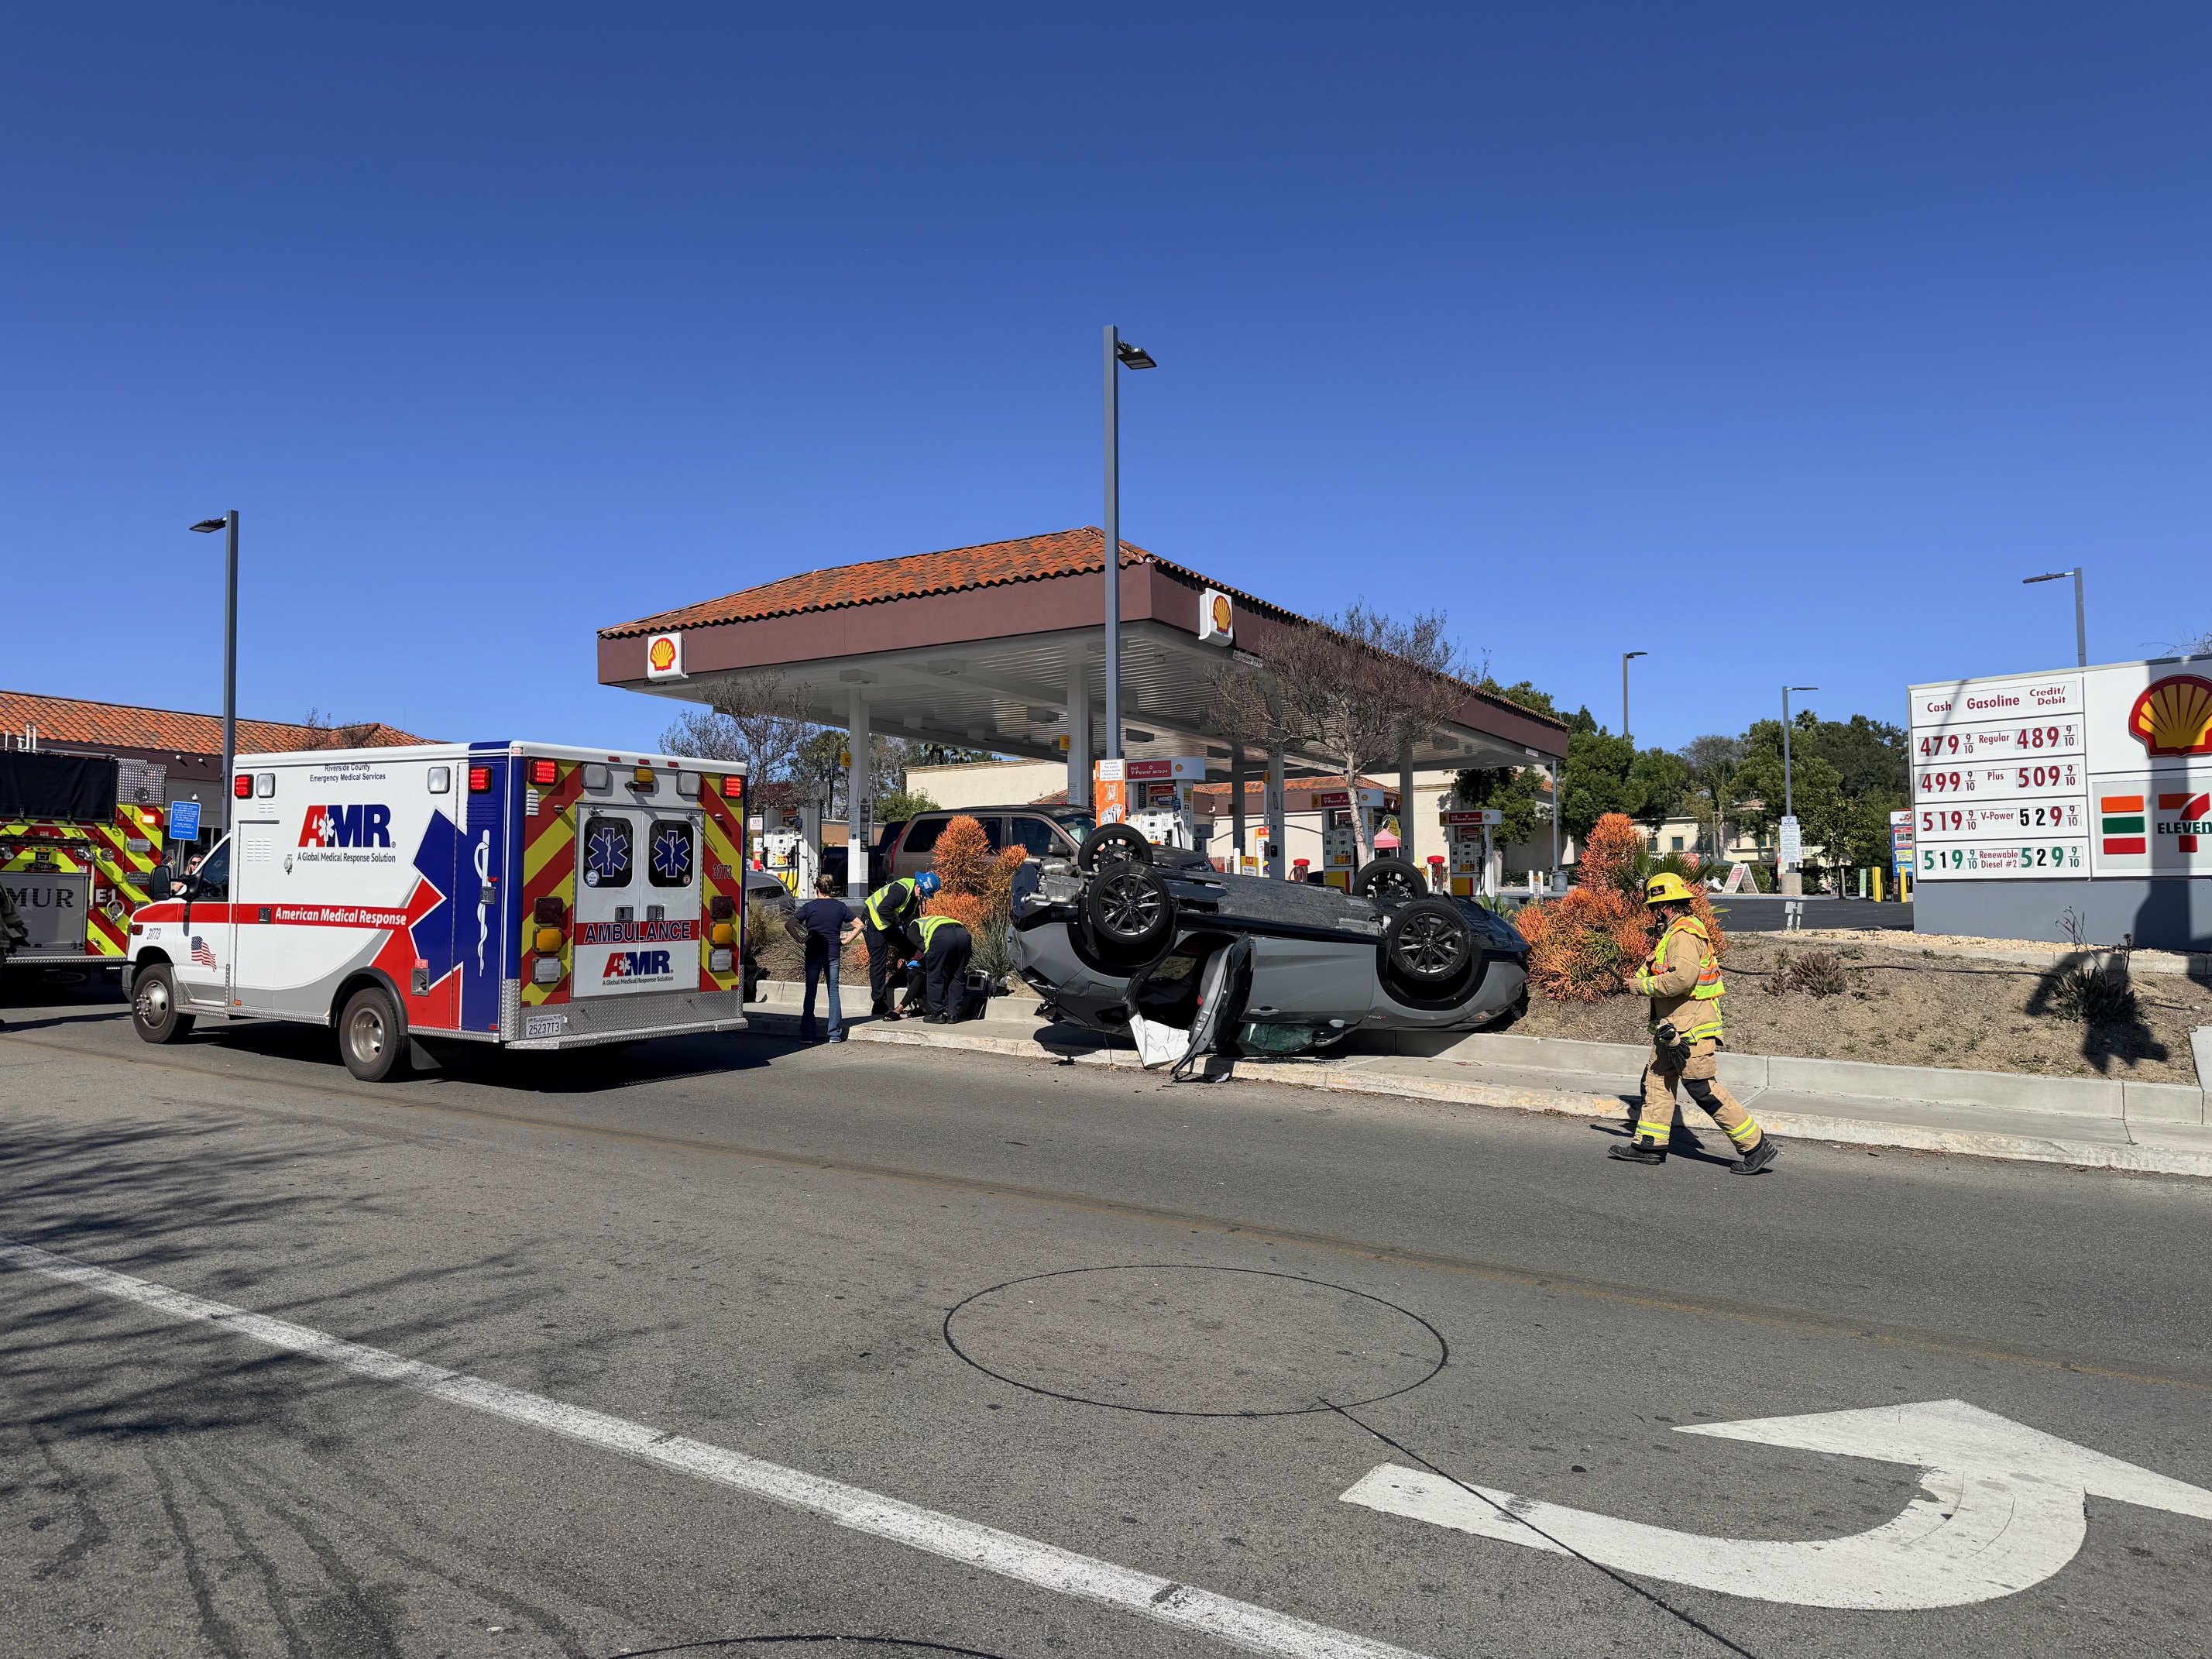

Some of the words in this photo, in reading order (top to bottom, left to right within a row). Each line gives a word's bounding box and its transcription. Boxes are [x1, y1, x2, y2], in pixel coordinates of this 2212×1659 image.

[2029, 685, 2066, 696] Credit/
[1927, 700, 1952, 712] Cash
[1966, 695, 2020, 709] Gasoline
[2037, 696, 2066, 706] Debit
[1920, 734, 1960, 757] 479
[1979, 733, 2010, 745] Regular
[2017, 726, 2059, 749] 489
[310, 775, 338, 783] Emergency
[1922, 771, 1961, 793] 499
[1987, 771, 2004, 781] Plus
[2018, 765, 2060, 788] 509
[297, 804, 391, 847] AMR
[1922, 810, 1963, 832] 519
[1981, 811, 2014, 820] V-Power
[2019, 806, 2063, 826] 529
[297, 853, 302, 861] A
[302, 853, 319, 861] Global
[321, 853, 342, 862] Medical
[343, 854, 369, 864] Response
[371, 854, 396, 863] Solution
[1924, 849, 1963, 870] 519
[1979, 850, 2018, 859] Renewable
[2021, 847, 2064, 867] 529
[1980, 860, 2003, 868] Diesel
[2005, 860, 2017, 868] #2
[713, 864, 733, 879] 31773
[275, 907, 318, 921] American
[321, 908, 357, 922] Medical
[359, 910, 407, 927] Response
[583, 921, 691, 944] AMBULANCE
[603, 950, 671, 977] AMR
[528, 1022, 559, 1035] 25237T3
